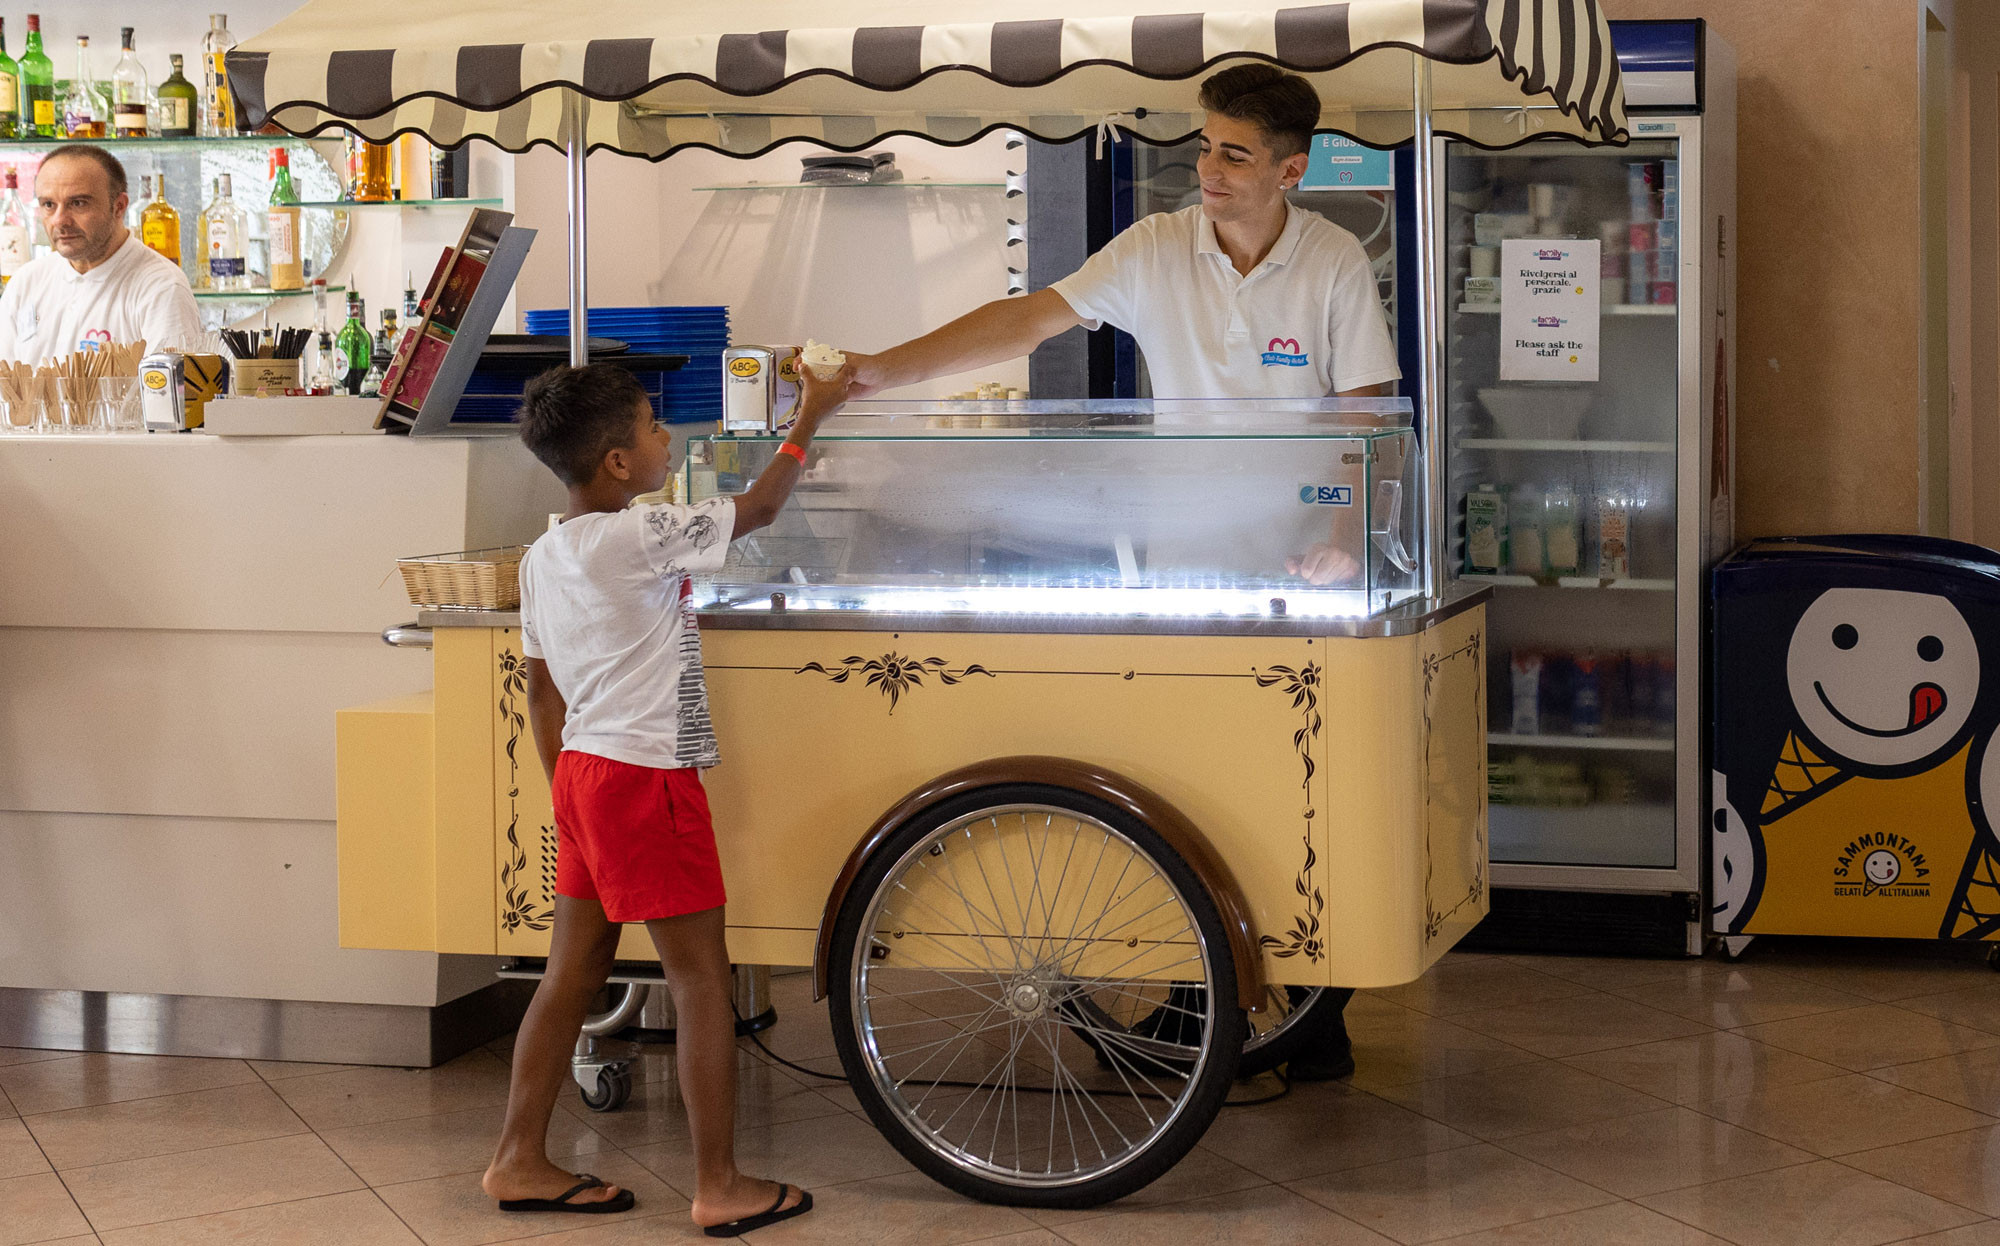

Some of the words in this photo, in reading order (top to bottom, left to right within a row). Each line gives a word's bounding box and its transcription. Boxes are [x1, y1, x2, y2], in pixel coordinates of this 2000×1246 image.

[1332, 138, 1361, 148] GIUS
[1520, 269, 1566, 279] Rivolgersi
[1568, 271, 1577, 279] al
[1532, 287, 1561, 295] grazie
[1515, 340, 1546, 348] Please
[1547, 341, 1565, 349] ask
[1567, 341, 1583, 349] the
[1536, 349, 1560, 357] staff
[731, 362, 751, 372] ABC
[145, 375, 159, 384] ABC
[1318, 486, 1341, 500] ISA
[1834, 831, 1930, 878] SAMMONTANA
[1834, 887, 1861, 896] GELATI
[1878, 887, 1931, 897] ALL'ITALIANA
